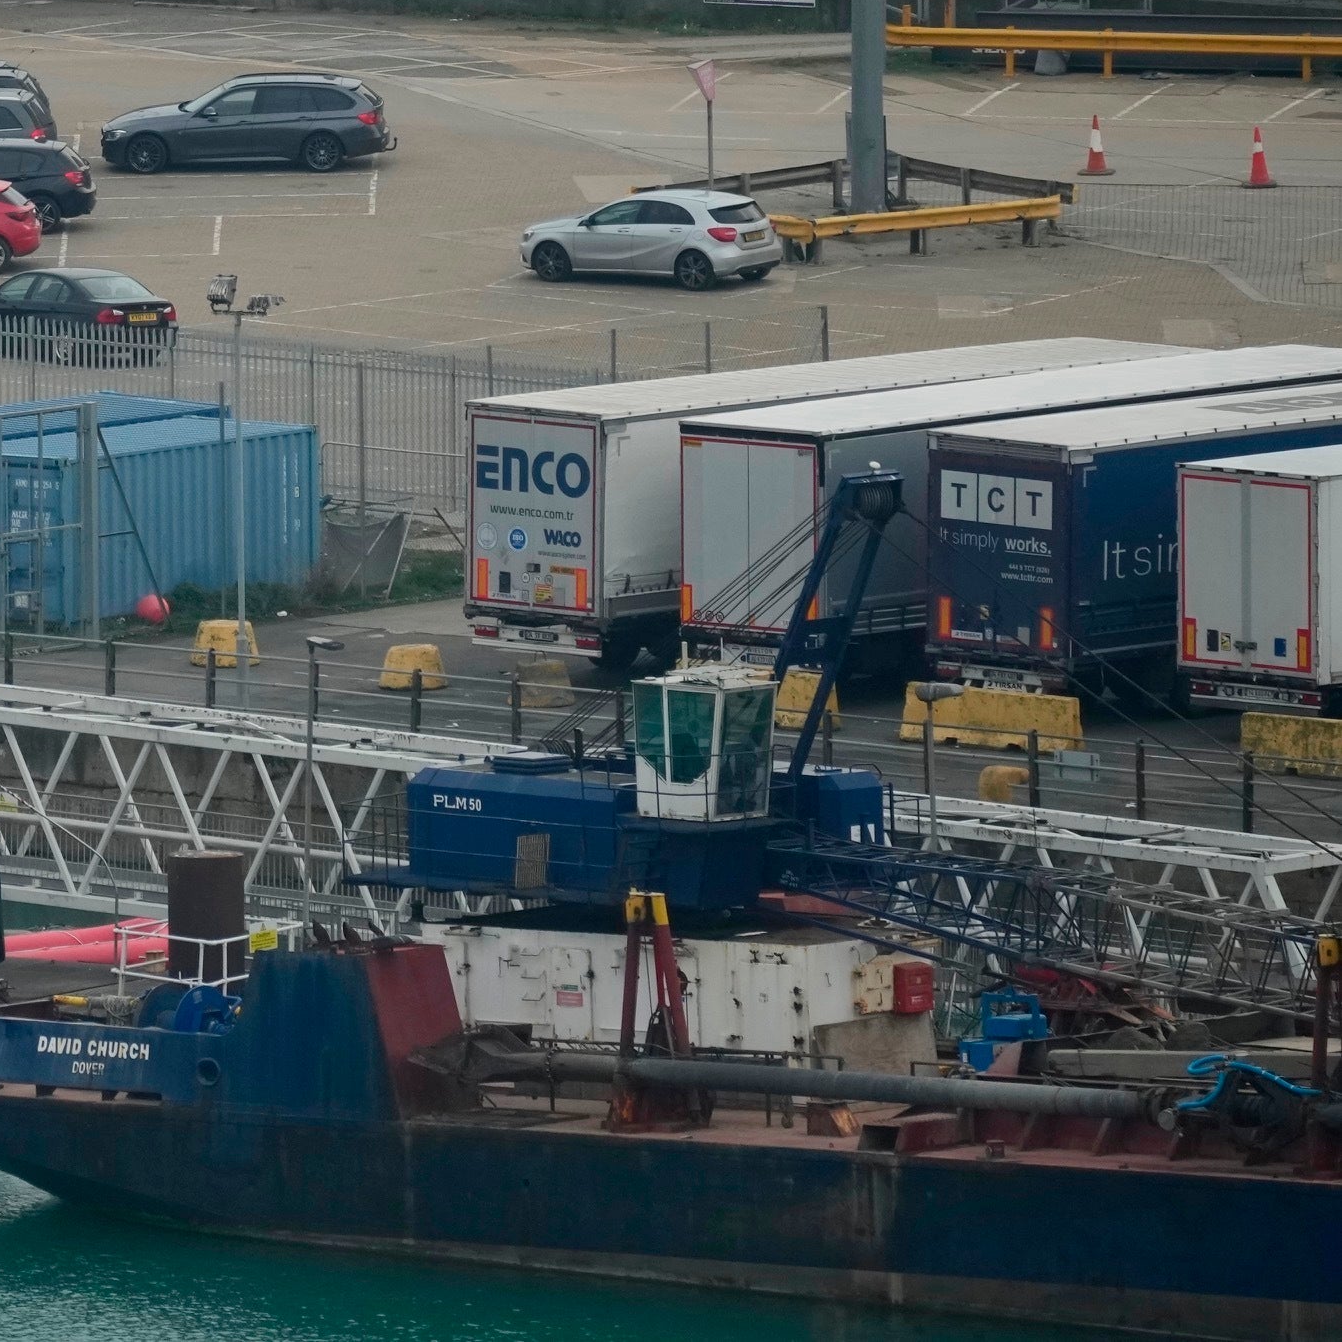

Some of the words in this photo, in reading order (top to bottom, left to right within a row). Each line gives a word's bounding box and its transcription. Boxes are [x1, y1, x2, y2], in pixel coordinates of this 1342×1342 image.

[476, 444, 591, 499] ENCO
[950, 482, 1044, 516] TCT
[490, 504, 575, 521] www.enco.com.tr
[940, 527, 948, 542] It
[952, 529, 999, 553] simply
[1004, 536, 1051, 555] works.
[1103, 540, 1126, 581] It
[1001, 572, 1054, 584] www.tcttr.com
[995, 682, 1022, 691] TIRSAN
[433, 794, 467, 811] PLM
[469, 798, 482, 812] 50
[37, 1035, 81, 1056] DAVID
[87, 1040, 150, 1061] CHURCH
[71, 1061, 105, 1076] DOVER
